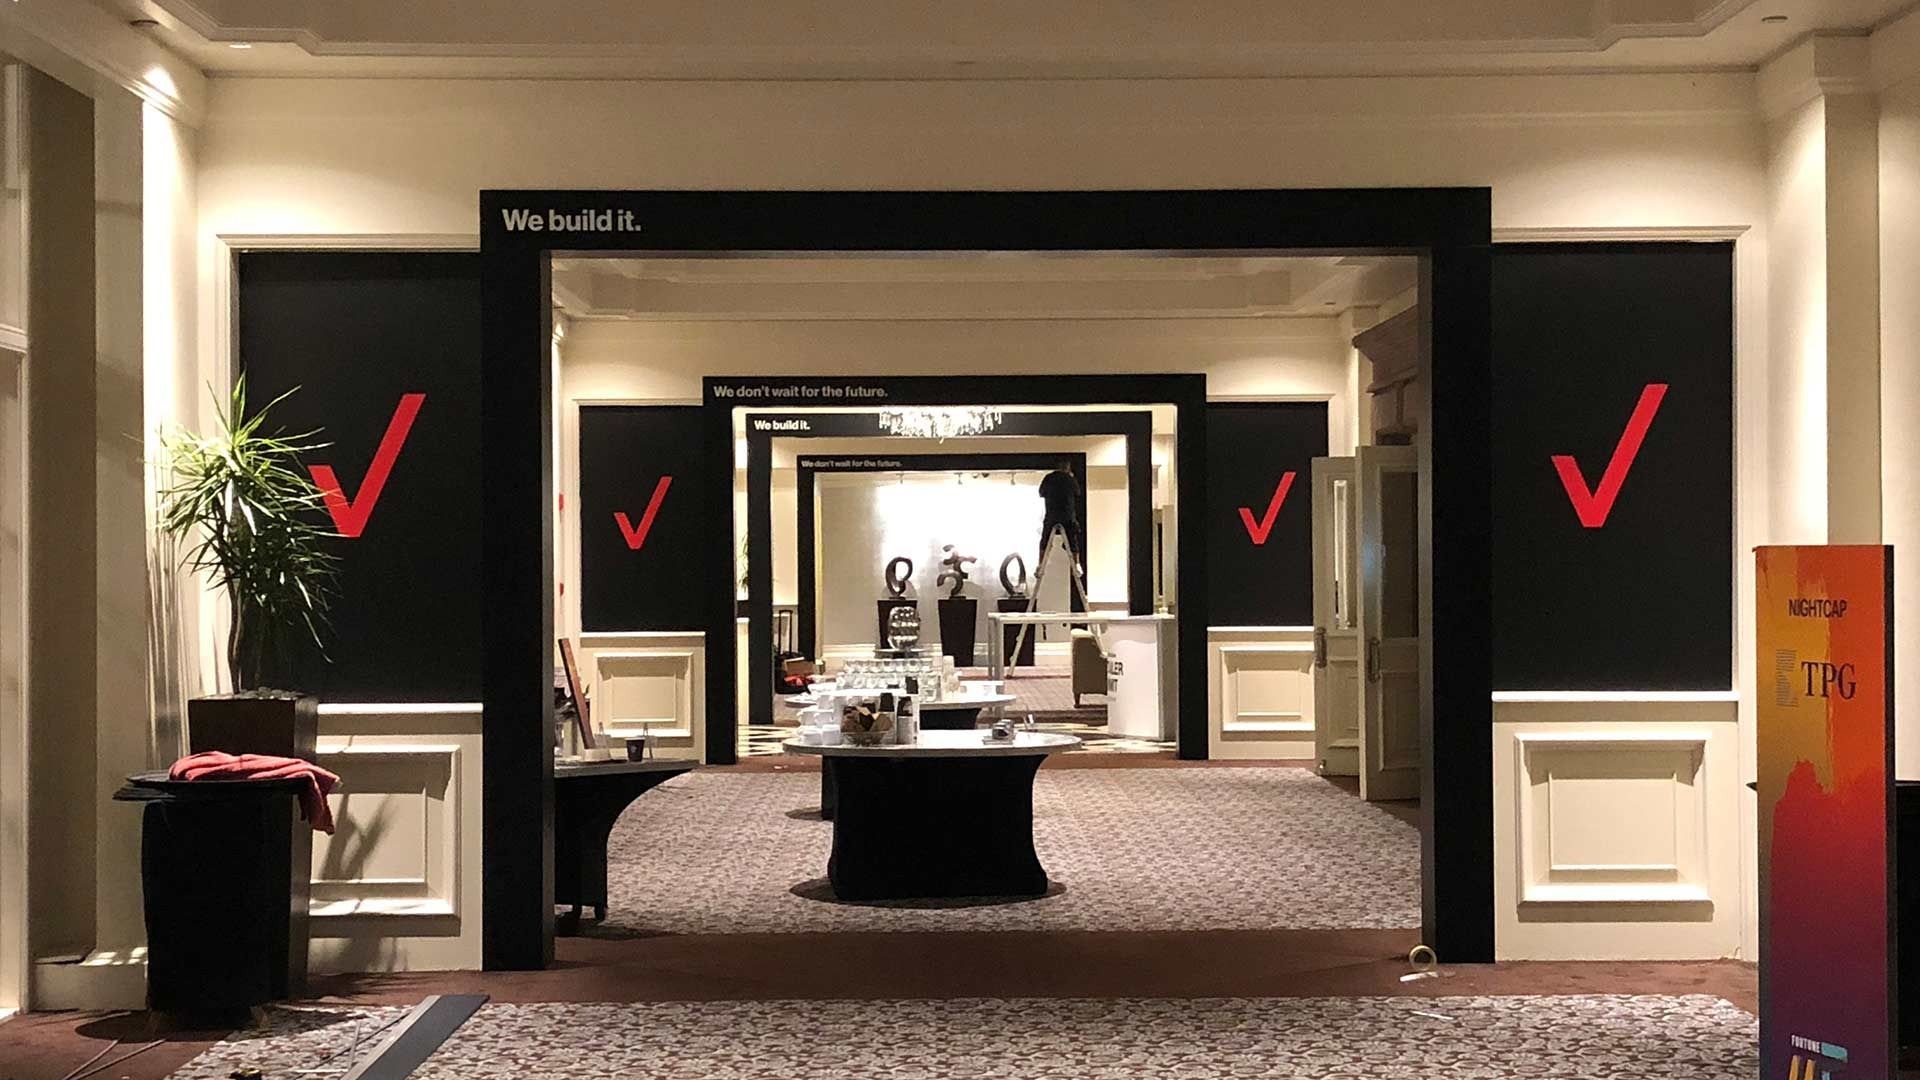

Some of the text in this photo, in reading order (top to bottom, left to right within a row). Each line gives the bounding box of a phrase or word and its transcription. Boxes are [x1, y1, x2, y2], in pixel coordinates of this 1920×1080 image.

[502, 209, 642, 231] We build it.
[713, 385, 888, 397] We don't wait for the future.
[754, 419, 811, 430] We build it.
[801, 460, 813, 468] We
[1788, 598, 1848, 618] NIGHTCAP
[1801, 661, 1857, 700] TPG
[1791, 1034, 1820, 1054] FORTUNE
